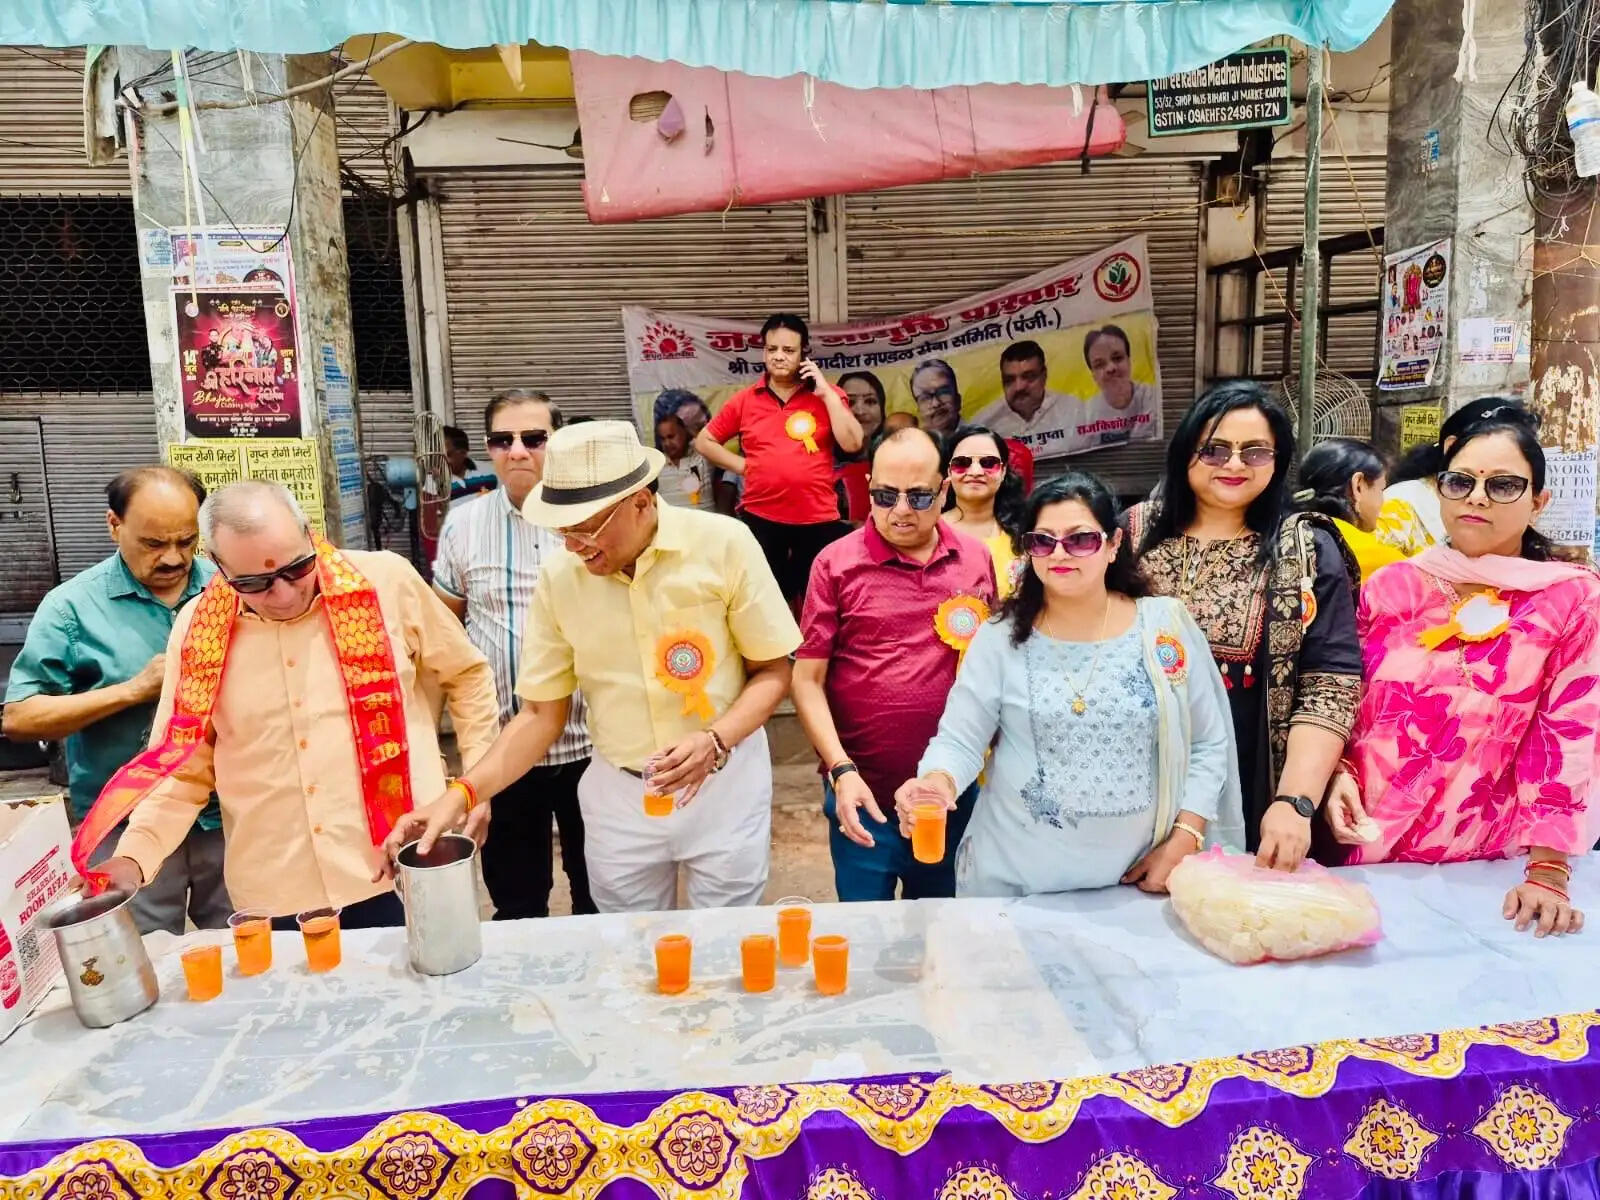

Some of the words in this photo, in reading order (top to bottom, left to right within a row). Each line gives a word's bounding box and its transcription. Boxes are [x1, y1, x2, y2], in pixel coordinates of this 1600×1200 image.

[1207, 58, 1241, 87] Madhav
[1241, 55, 1287, 84] Industries
[1174, 94, 1191, 107] SHOP
[1231, 90, 1239, 102] JI
[1154, 113, 1187, 128] GSTIN:
[727, 356, 750, 375] श्री
[195, 449, 214, 462] रोगी
[19, 892, 46, 926] ROOH
